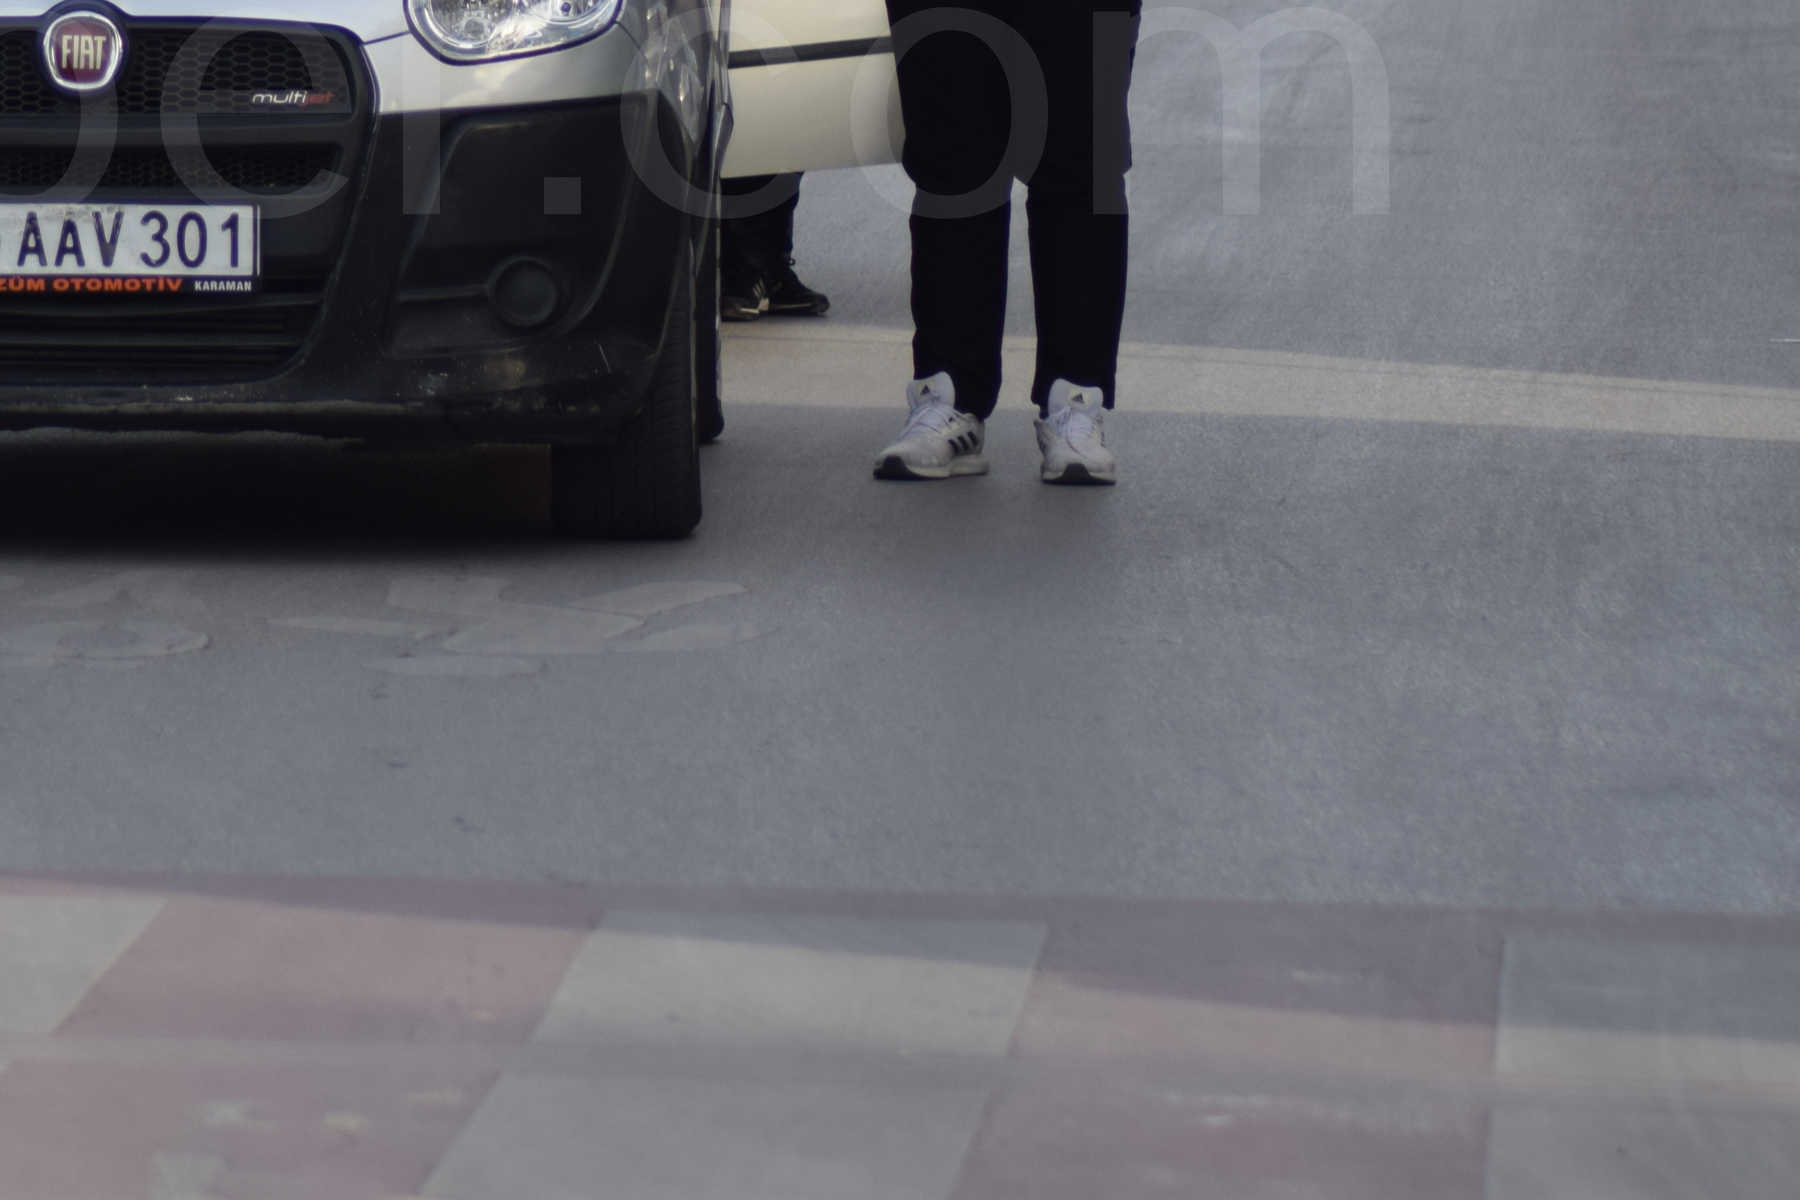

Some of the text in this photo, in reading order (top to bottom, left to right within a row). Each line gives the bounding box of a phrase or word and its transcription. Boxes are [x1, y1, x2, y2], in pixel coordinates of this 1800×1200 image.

[62, 35, 106, 69] FIAT
[17, 211, 125, 268] AAV
[140, 211, 239, 268] 301
[53, 275, 183, 292] OTOMOTİV
[194, 281, 252, 291] KARAMAN
